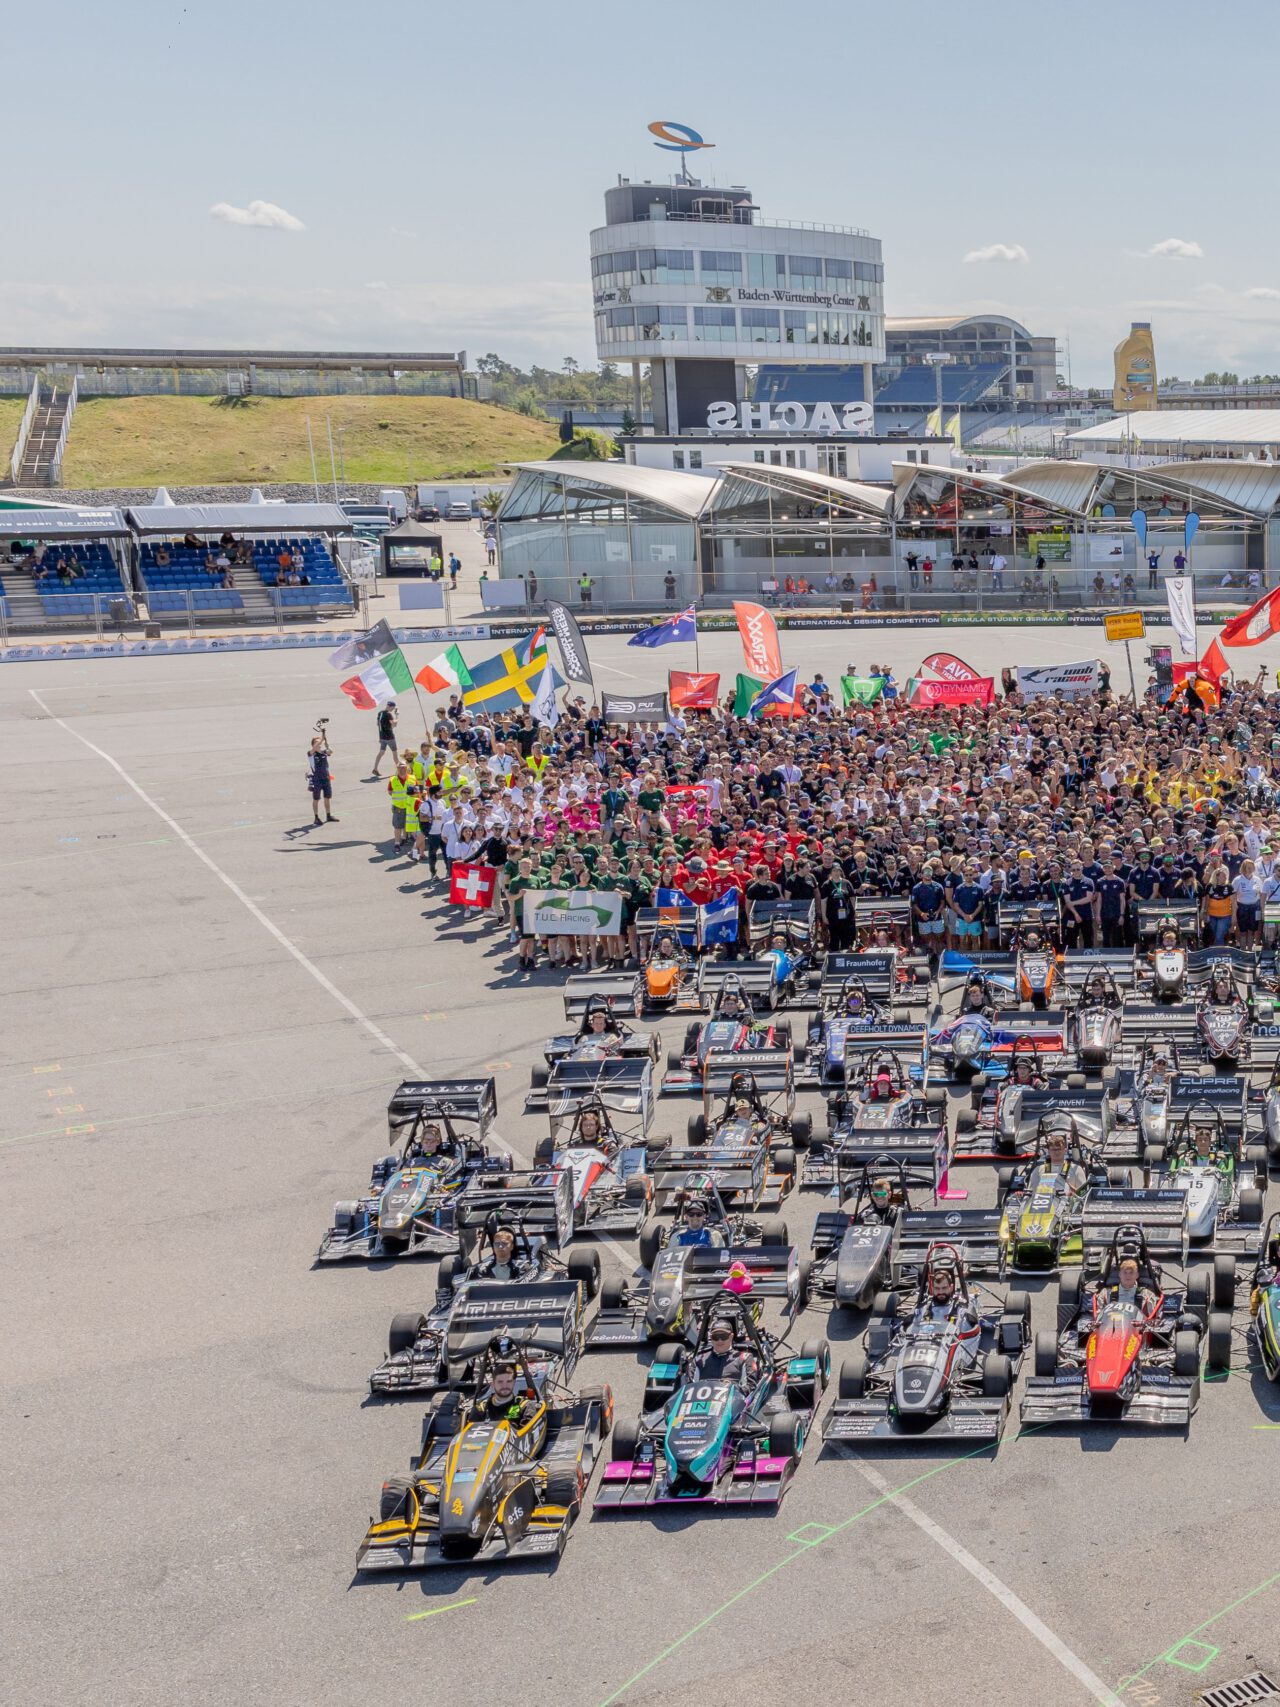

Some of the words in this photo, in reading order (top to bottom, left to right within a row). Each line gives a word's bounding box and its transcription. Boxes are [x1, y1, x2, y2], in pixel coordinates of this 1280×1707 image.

[738, 288, 832, 308] Baden-Württemberg
[833, 295, 856, 307] Center
[846, 958, 887, 968] Fraunhofer
[1027, 966, 1047, 974] 123
[1166, 966, 1179, 974] 141
[893, 1023, 926, 1033] DYNAMICS
[1180, 1077, 1237, 1085] CUPRA
[404, 1084, 486, 1095] VOLVO
[1058, 1099, 1086, 1107] INVENT
[863, 1112, 886, 1120] 122
[858, 1136, 931, 1146] TESLA
[1188, 1180, 1203, 1189] 15
[1032, 1193, 1051, 1210] 187
[852, 1227, 882, 1237] 249
[663, 1250, 683, 1263] 11
[492, 1297, 566, 1311] TEUFEL
[1102, 1301, 1135, 1313] 240
[684, 1386, 728, 1402] 107
[507, 1506, 524, 1526] e:fs
